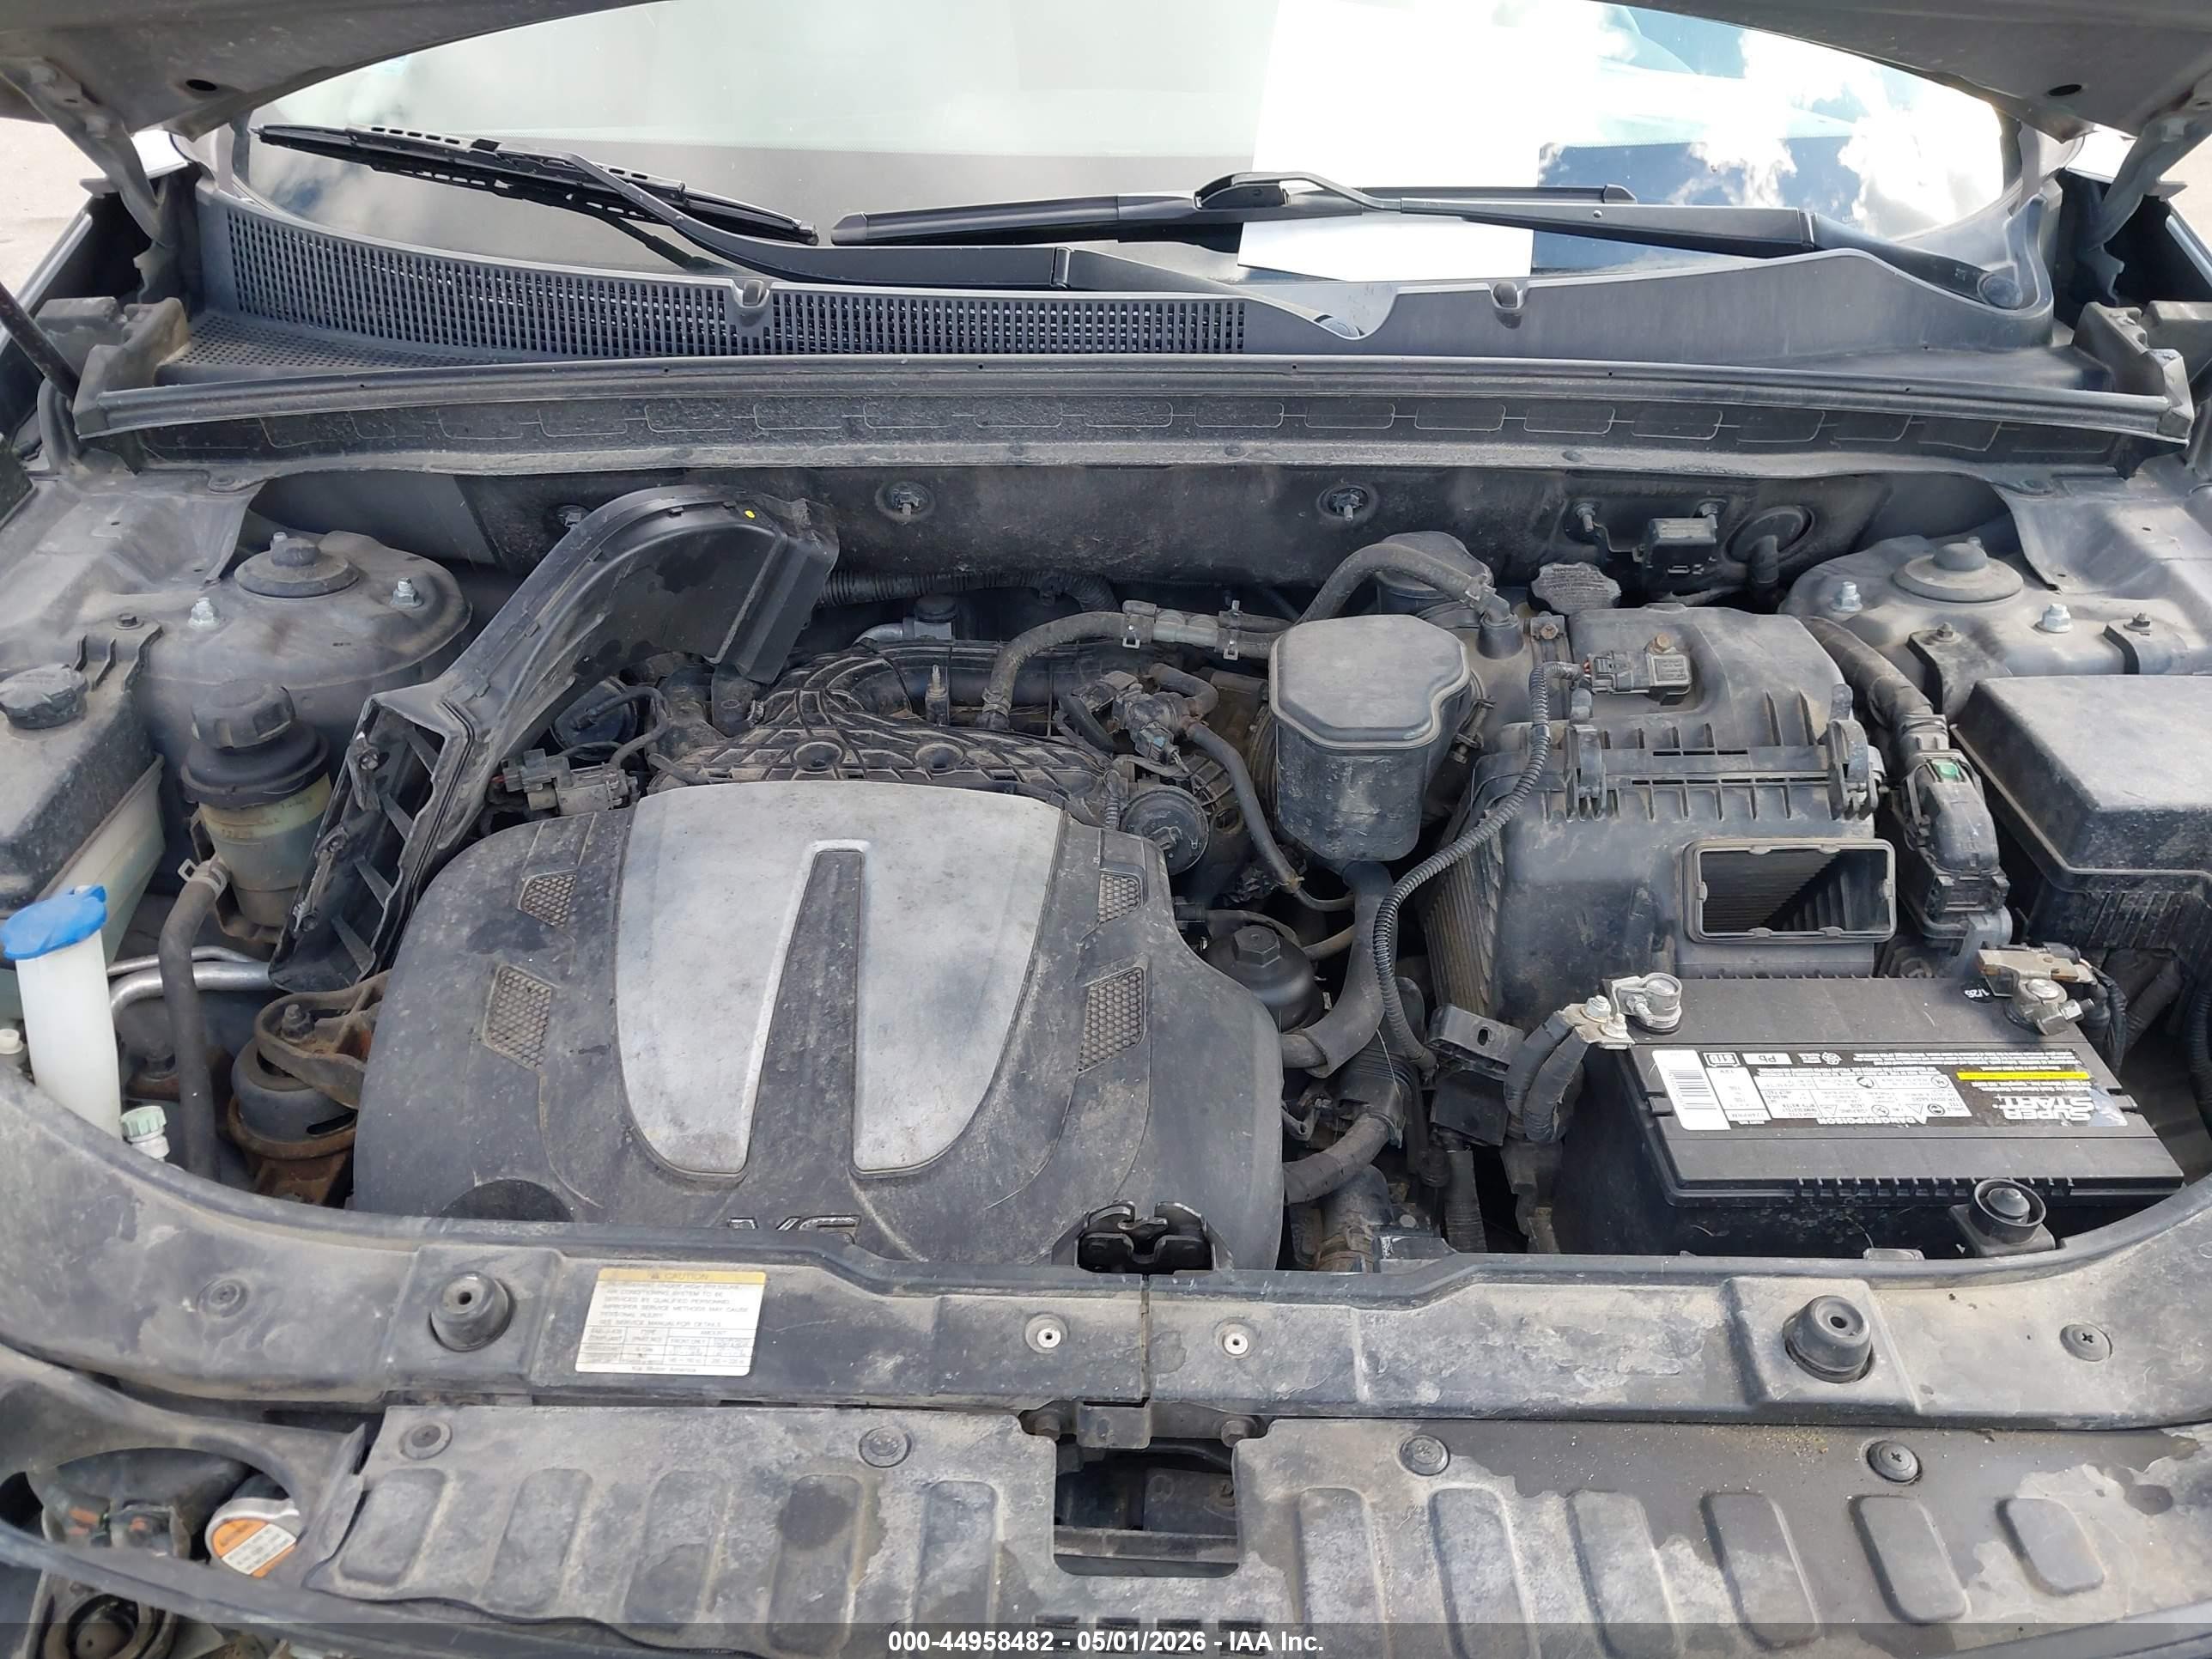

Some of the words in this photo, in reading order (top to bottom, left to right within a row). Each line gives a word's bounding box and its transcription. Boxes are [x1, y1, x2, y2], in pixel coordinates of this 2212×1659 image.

[1759, 1054, 1777, 1063] Pb
[1998, 1097, 2094, 1109] START
[2002, 1109, 2092, 1121] SUPER
